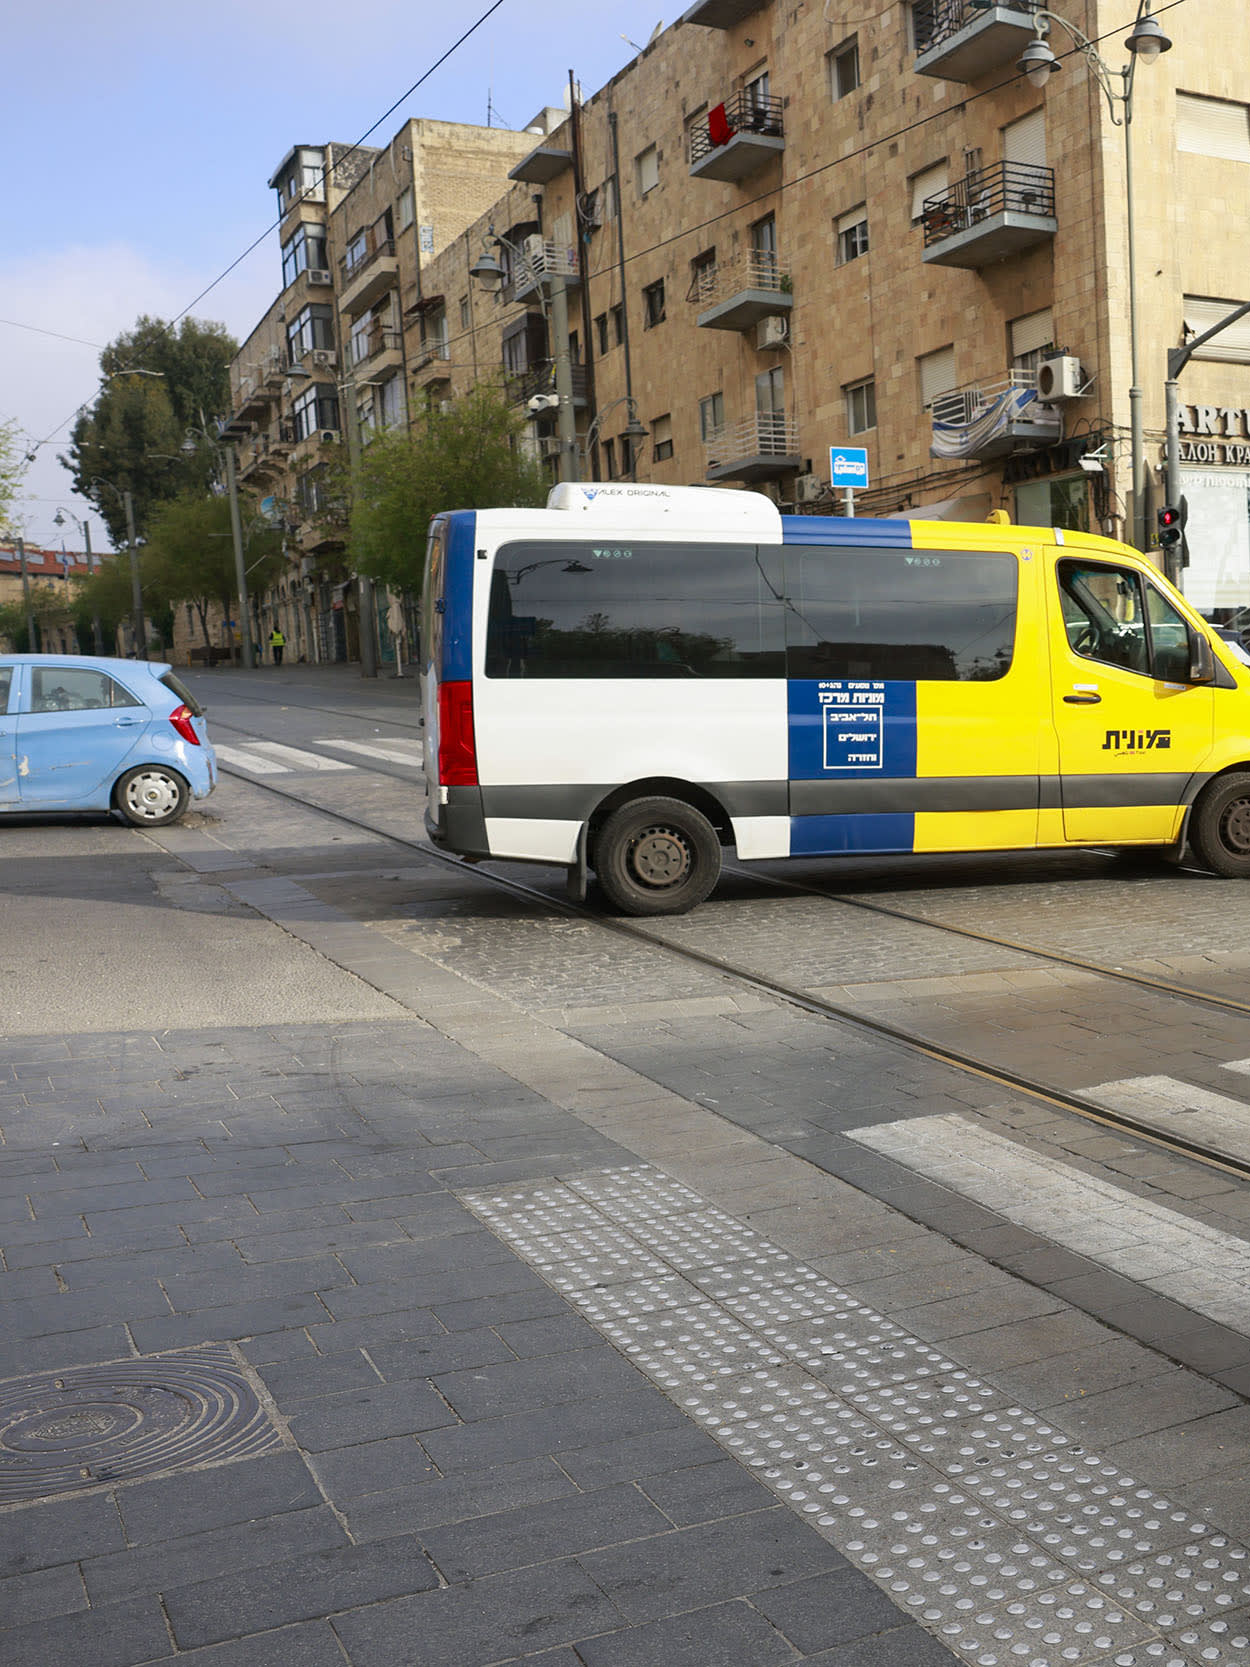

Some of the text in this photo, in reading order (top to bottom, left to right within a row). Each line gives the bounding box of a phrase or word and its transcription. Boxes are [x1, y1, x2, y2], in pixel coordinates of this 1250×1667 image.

[1164, 442, 1218, 464] АЛОН
[818, 692, 885, 703] מוניות מרכז
[838, 733, 877, 742] ירושלים
[1102, 730, 1171, 749] מונית
[847, 753, 877, 762] וחזרה
